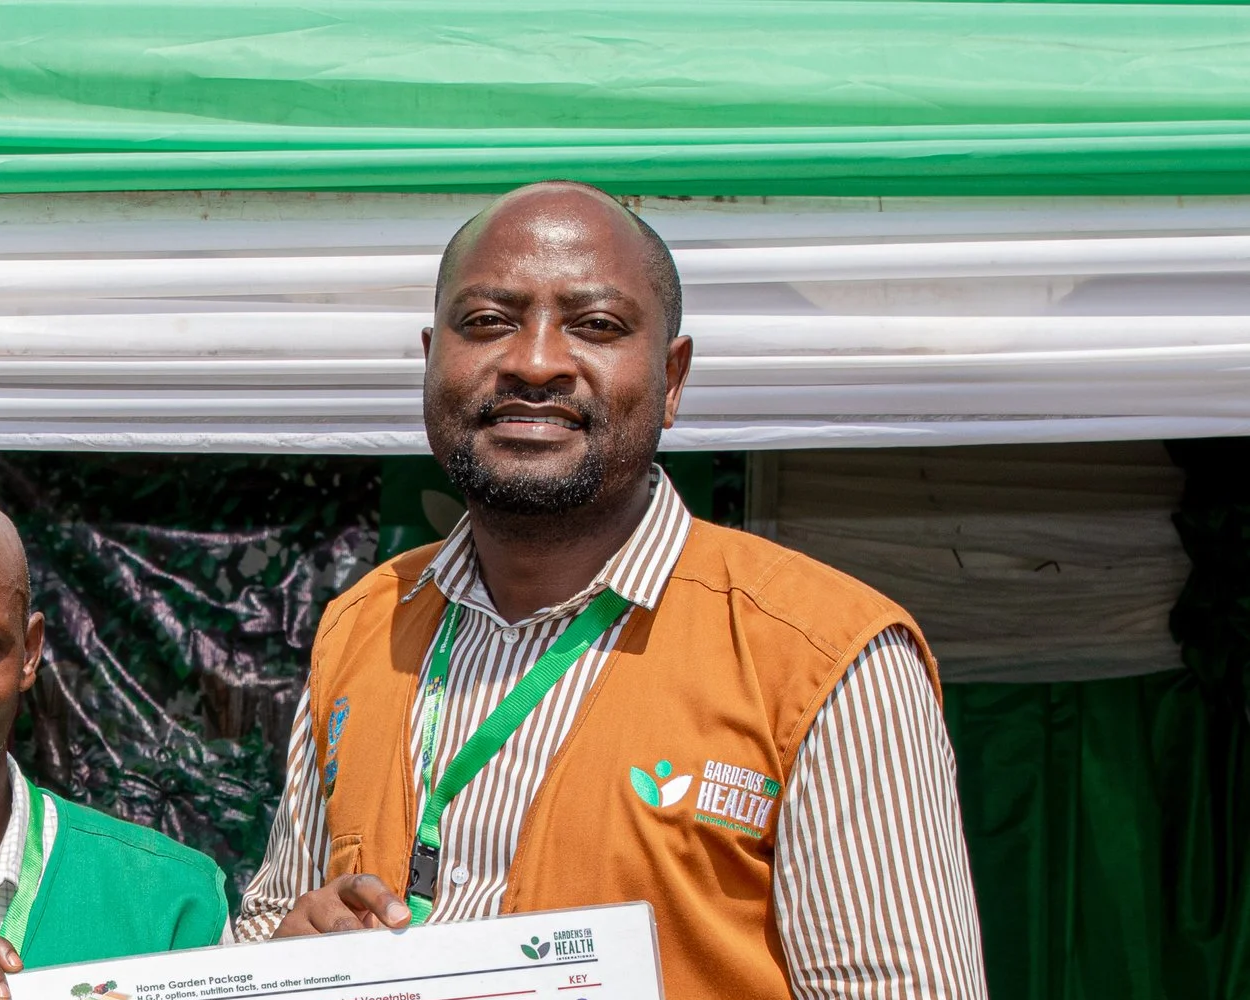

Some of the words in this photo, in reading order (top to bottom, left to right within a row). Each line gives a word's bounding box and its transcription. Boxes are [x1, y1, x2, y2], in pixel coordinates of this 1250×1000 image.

[704, 760, 765, 792] GARDENS
[696, 781, 773, 828] HEALTH
[553, 929, 583, 940] GARDENS
[555, 939, 594, 956] HEALTH
[136, 983, 165, 993] Home
[168, 978, 206, 990] Garden
[209, 973, 253, 987] Package
[165, 989, 199, 1000] options,
[200, 985, 234, 996] nutrition
[235, 983, 259, 993] facts,
[261, 980, 278, 989] and
[280, 977, 301, 987] other
[303, 974, 351, 985] information
[569, 974, 588, 984] KEY
